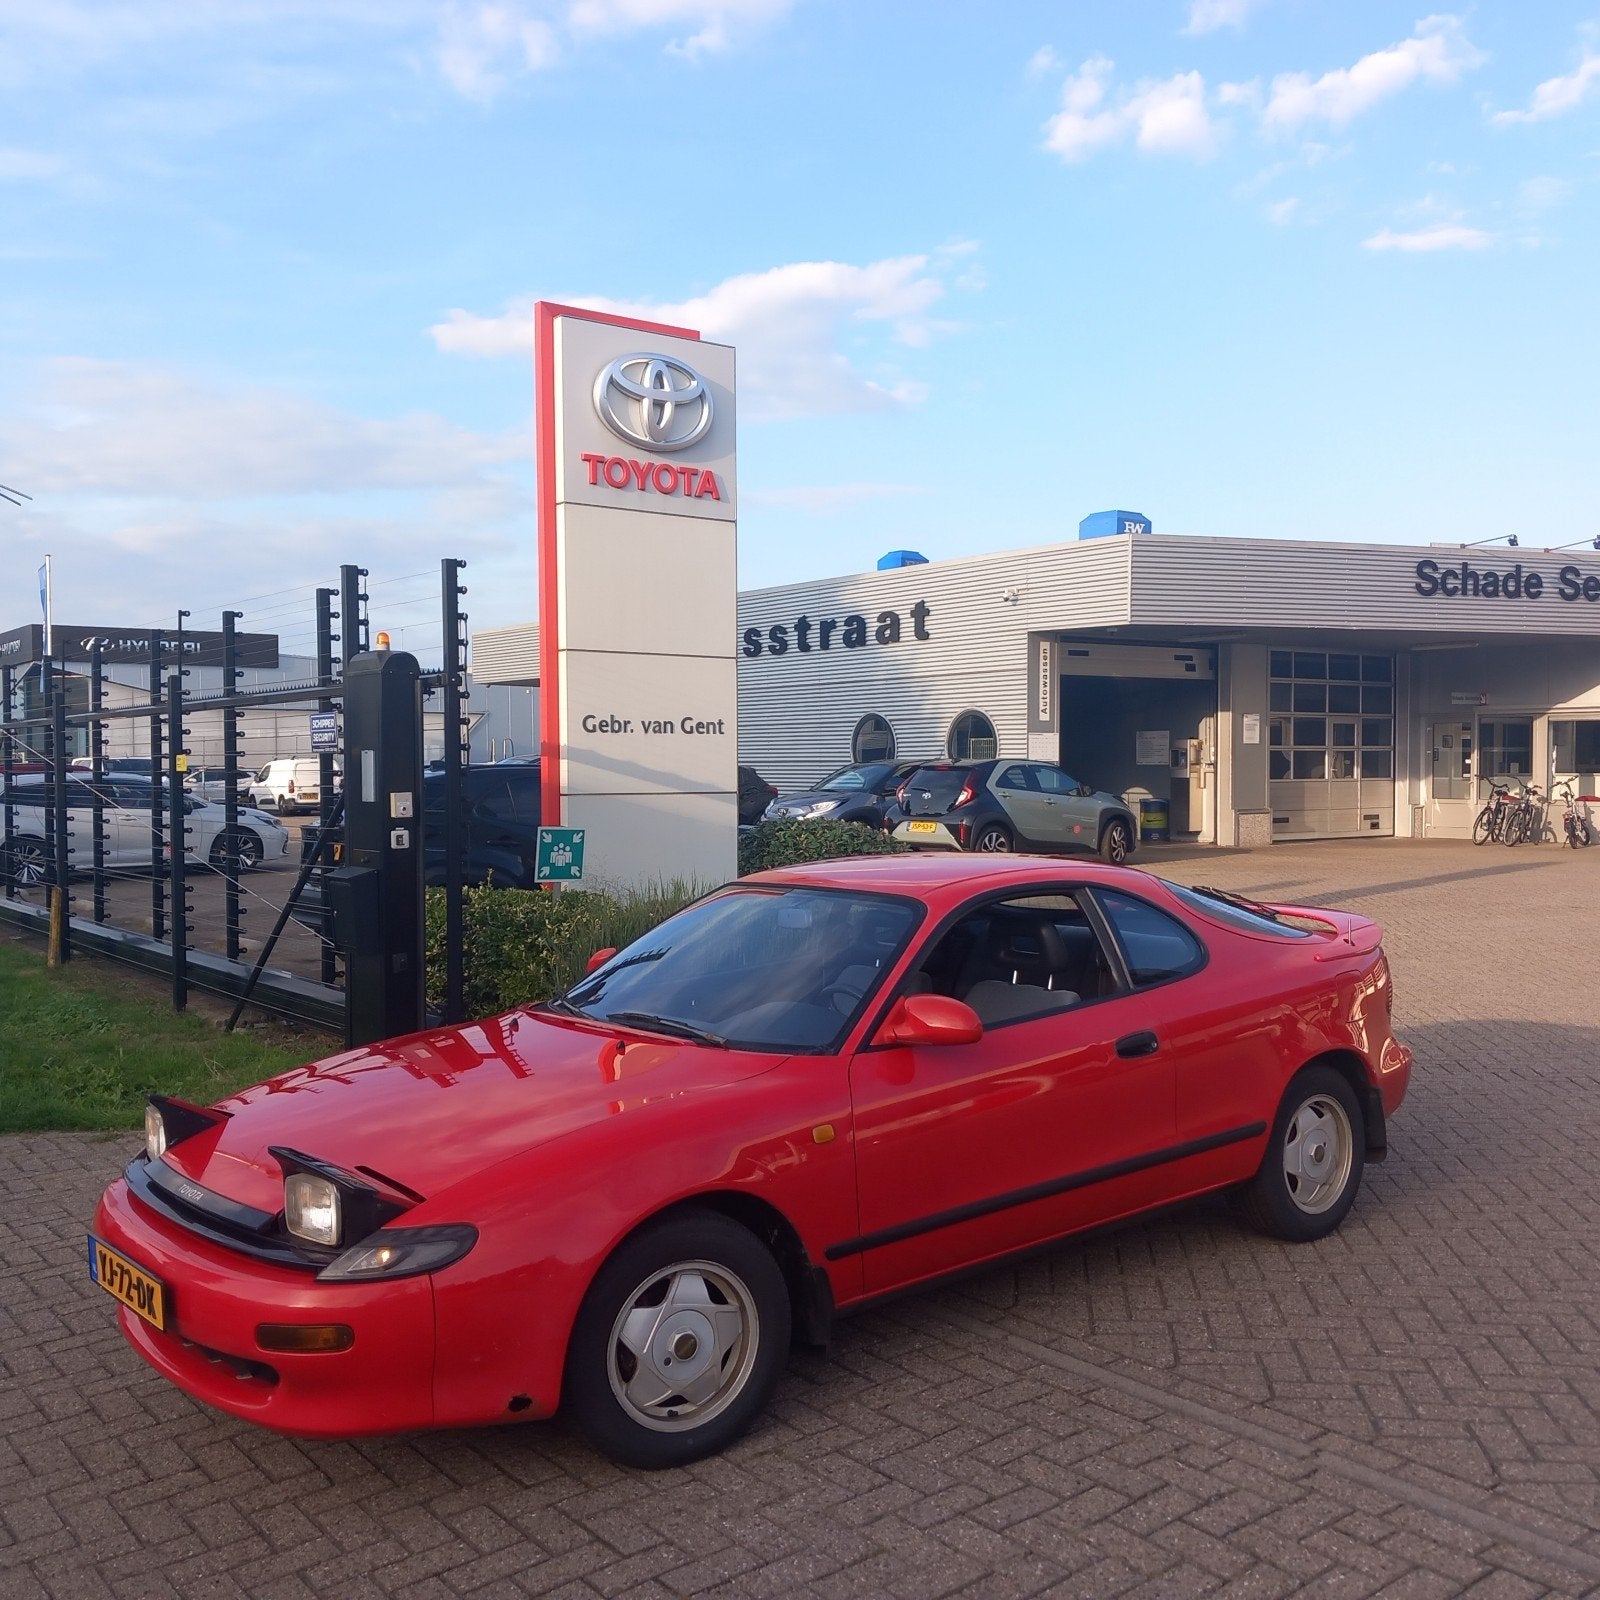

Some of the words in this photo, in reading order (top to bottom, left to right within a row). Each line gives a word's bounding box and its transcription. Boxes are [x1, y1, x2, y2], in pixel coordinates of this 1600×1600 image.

[581, 453, 720, 500] TOYOTA
[1415, 559, 1543, 599] Schade
[1559, 565, 1600, 601] Se
[742, 600, 930, 657] sstraat
[1040, 648, 1048, 714] Autowassen
[312, 719, 335, 729] SCHIPPER
[313, 733, 335, 742] SECURITY
[582, 714, 634, 734] Gebr.
[641, 719, 674, 734] van
[680, 716, 725, 735] Gent
[178, 1183, 204, 1201] TOYOTA
[99, 1250, 157, 1319] YJ-72-DK
